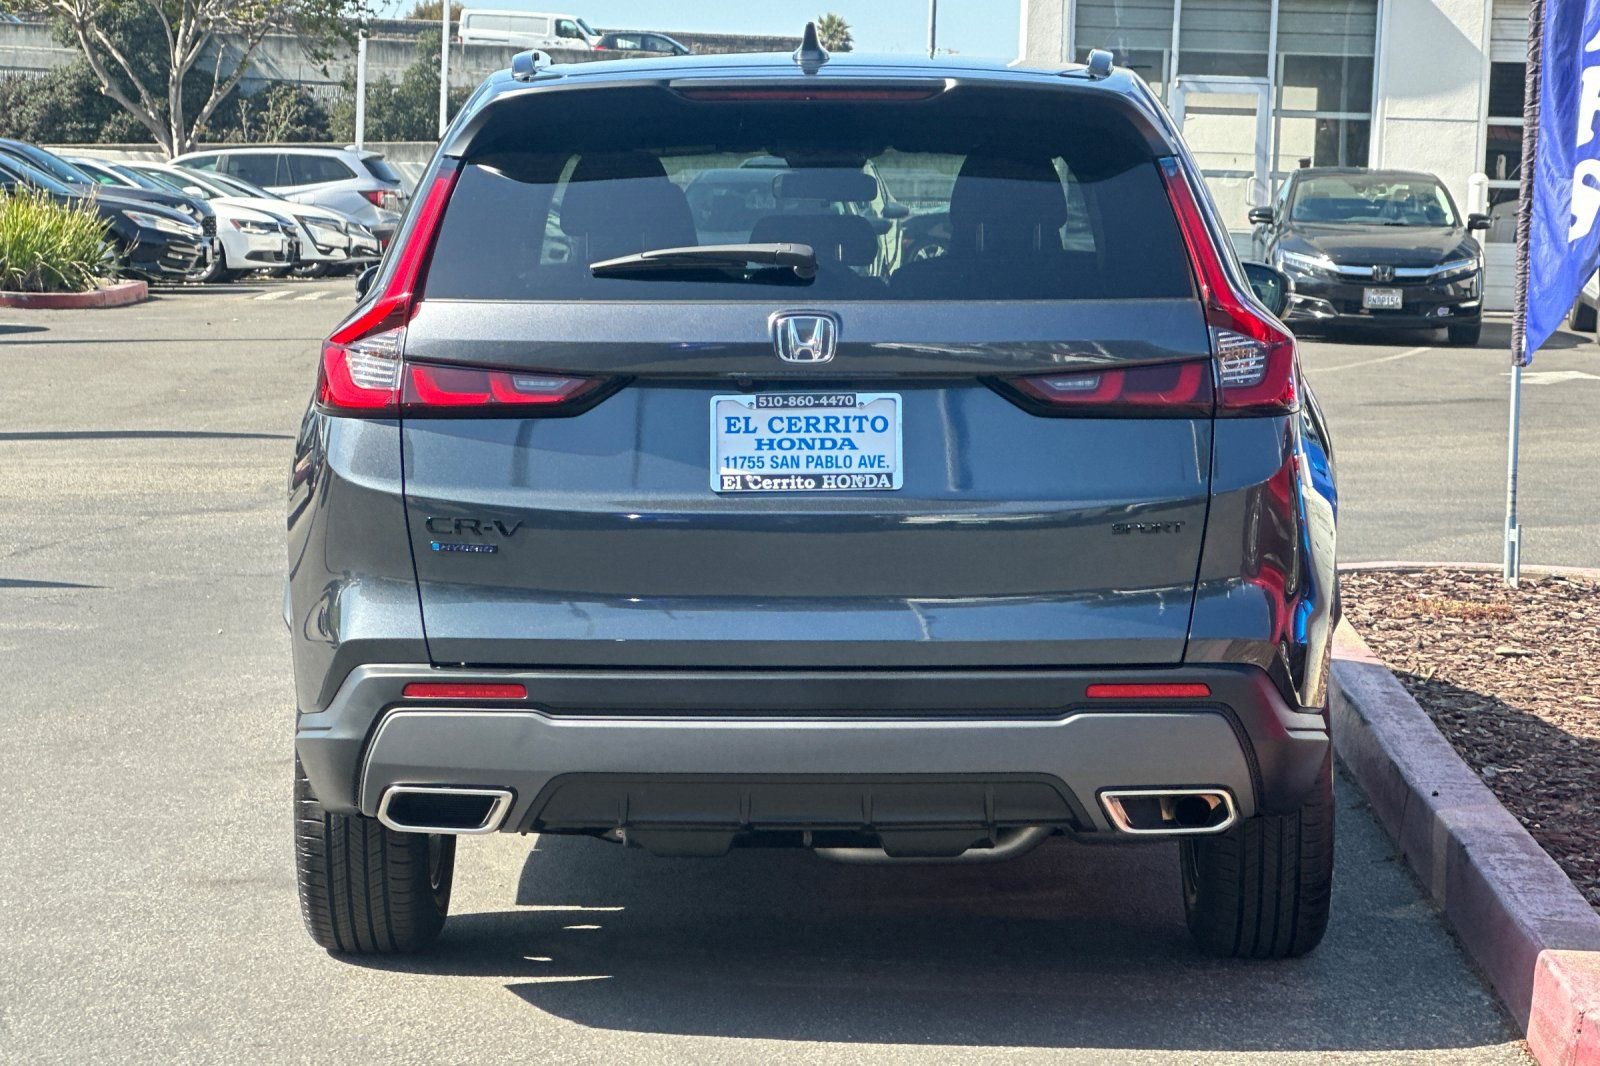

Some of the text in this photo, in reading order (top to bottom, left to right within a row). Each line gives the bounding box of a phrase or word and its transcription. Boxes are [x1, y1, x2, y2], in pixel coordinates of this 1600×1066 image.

[758, 395, 854, 407] 510-860-4470
[724, 415, 889, 434] EL CERRITO
[754, 437, 859, 451] HONDA
[723, 455, 890, 469] 11755 SAN PABLO AVE.
[722, 474, 891, 490] El Cerrito HONDA
[425, 517, 523, 537] CR-V
